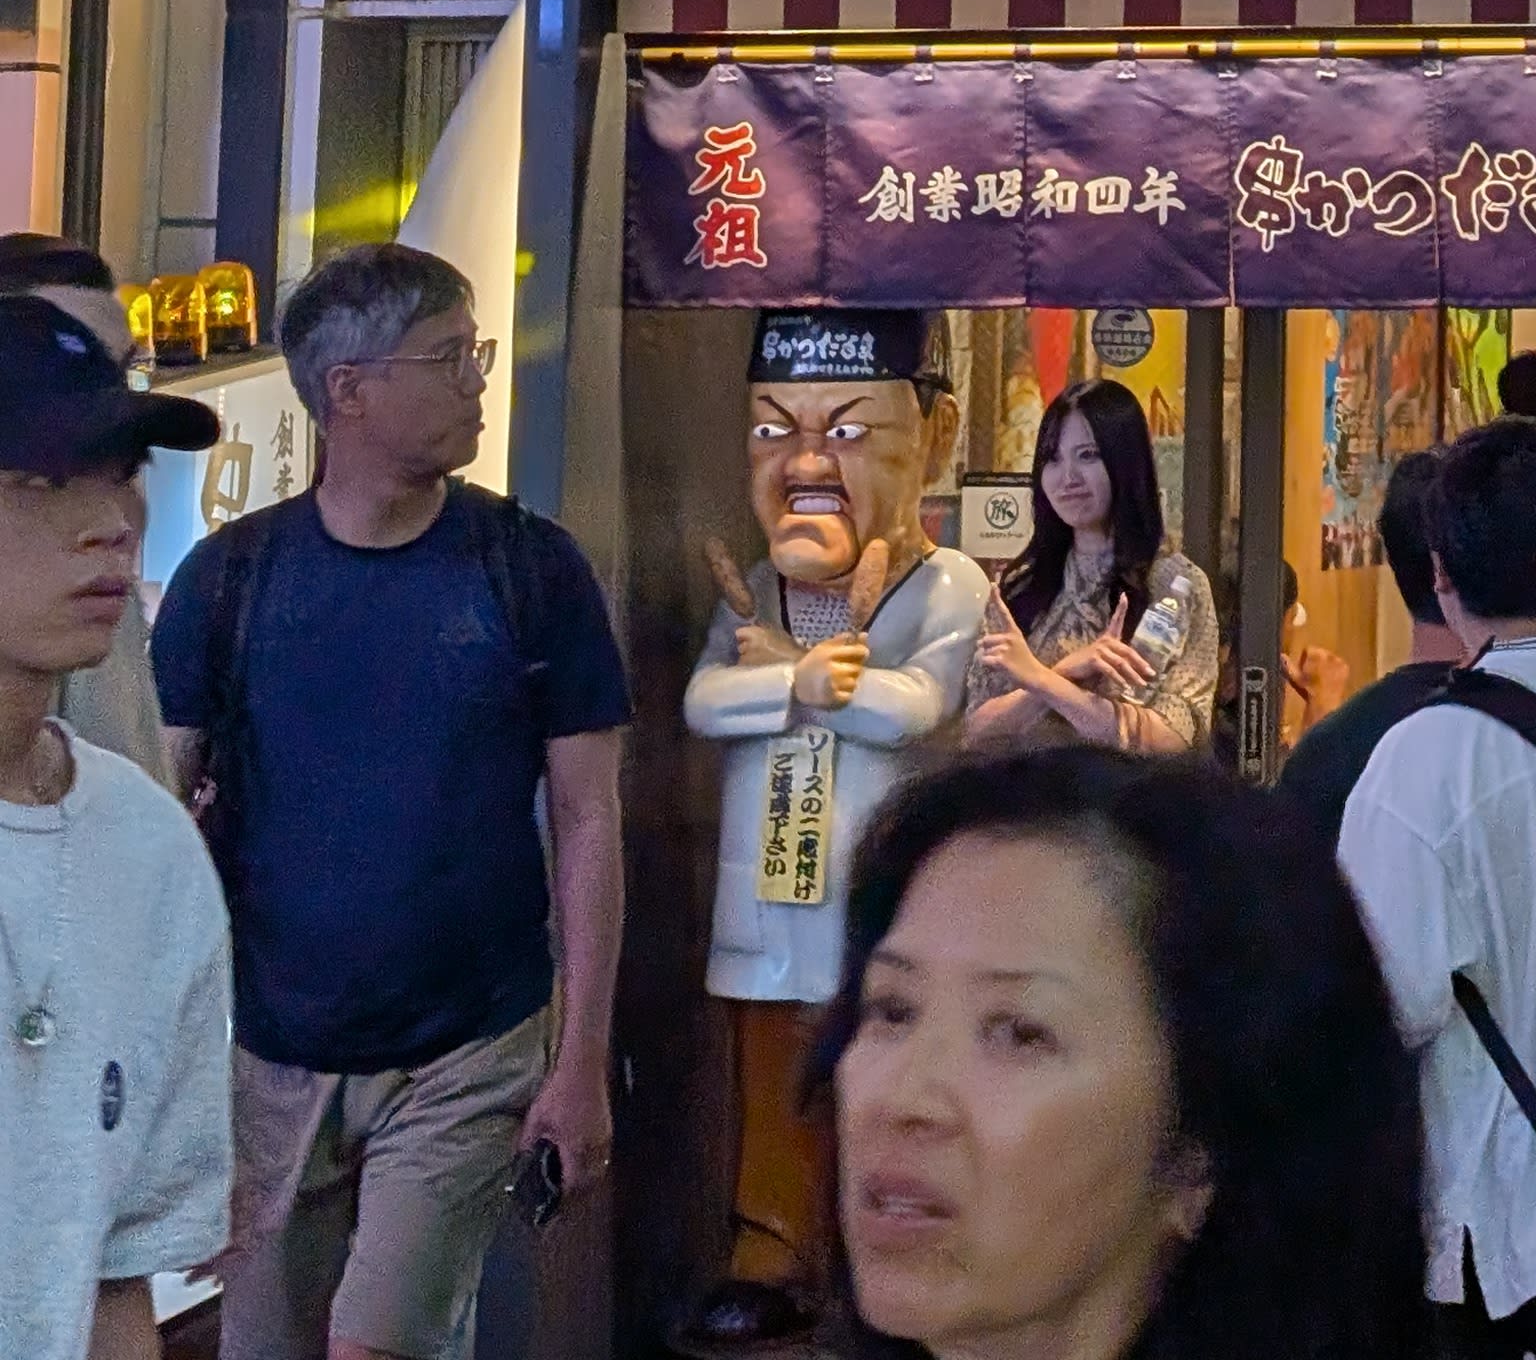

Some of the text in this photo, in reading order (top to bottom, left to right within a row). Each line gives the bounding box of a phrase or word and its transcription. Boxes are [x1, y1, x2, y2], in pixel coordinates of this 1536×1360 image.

[684, 121, 768, 270] 元祖
[857, 165, 1187, 226] 創業昭和四年
